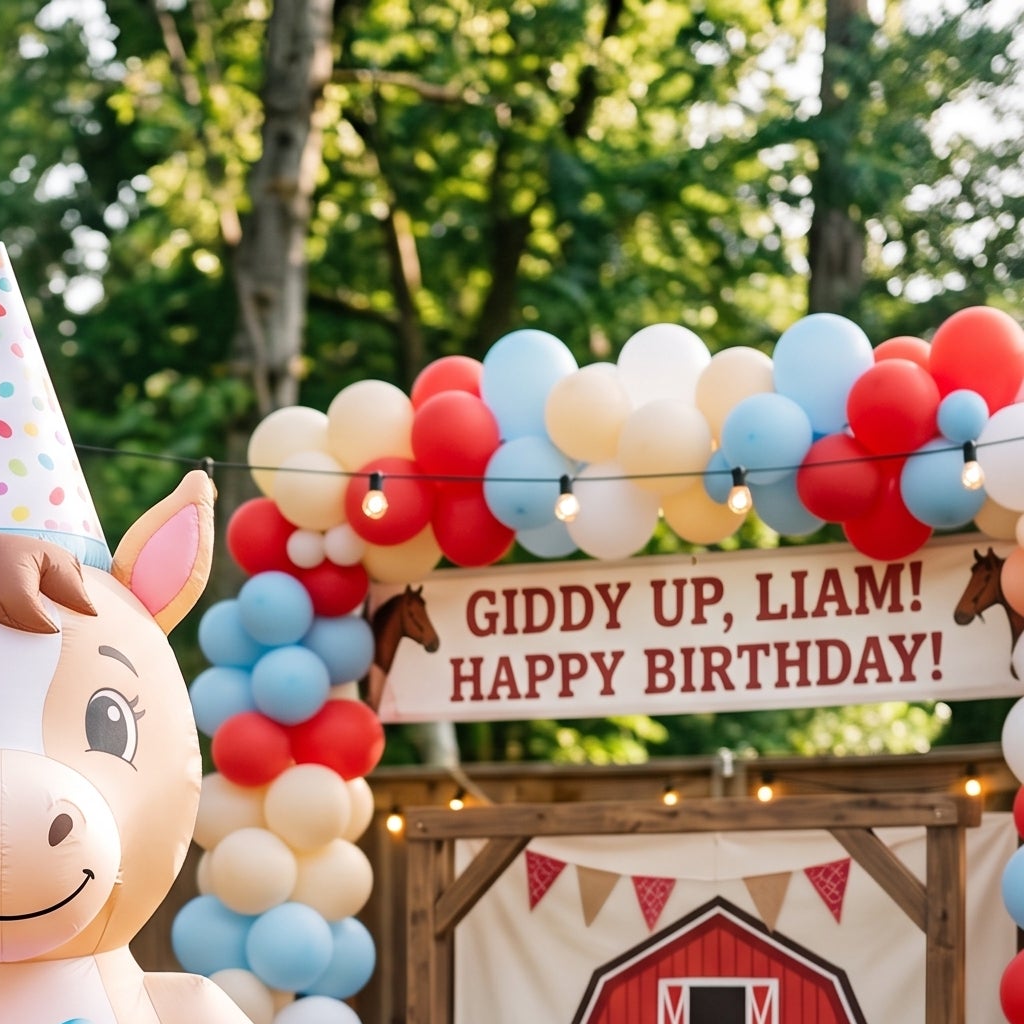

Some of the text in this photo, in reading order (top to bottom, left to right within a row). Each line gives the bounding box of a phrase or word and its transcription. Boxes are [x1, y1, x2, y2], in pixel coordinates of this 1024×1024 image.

[465, 560, 924, 638] GIDDY UP, LIAM!
[449, 631, 944, 702] HAPPY BIRTHDAY!
